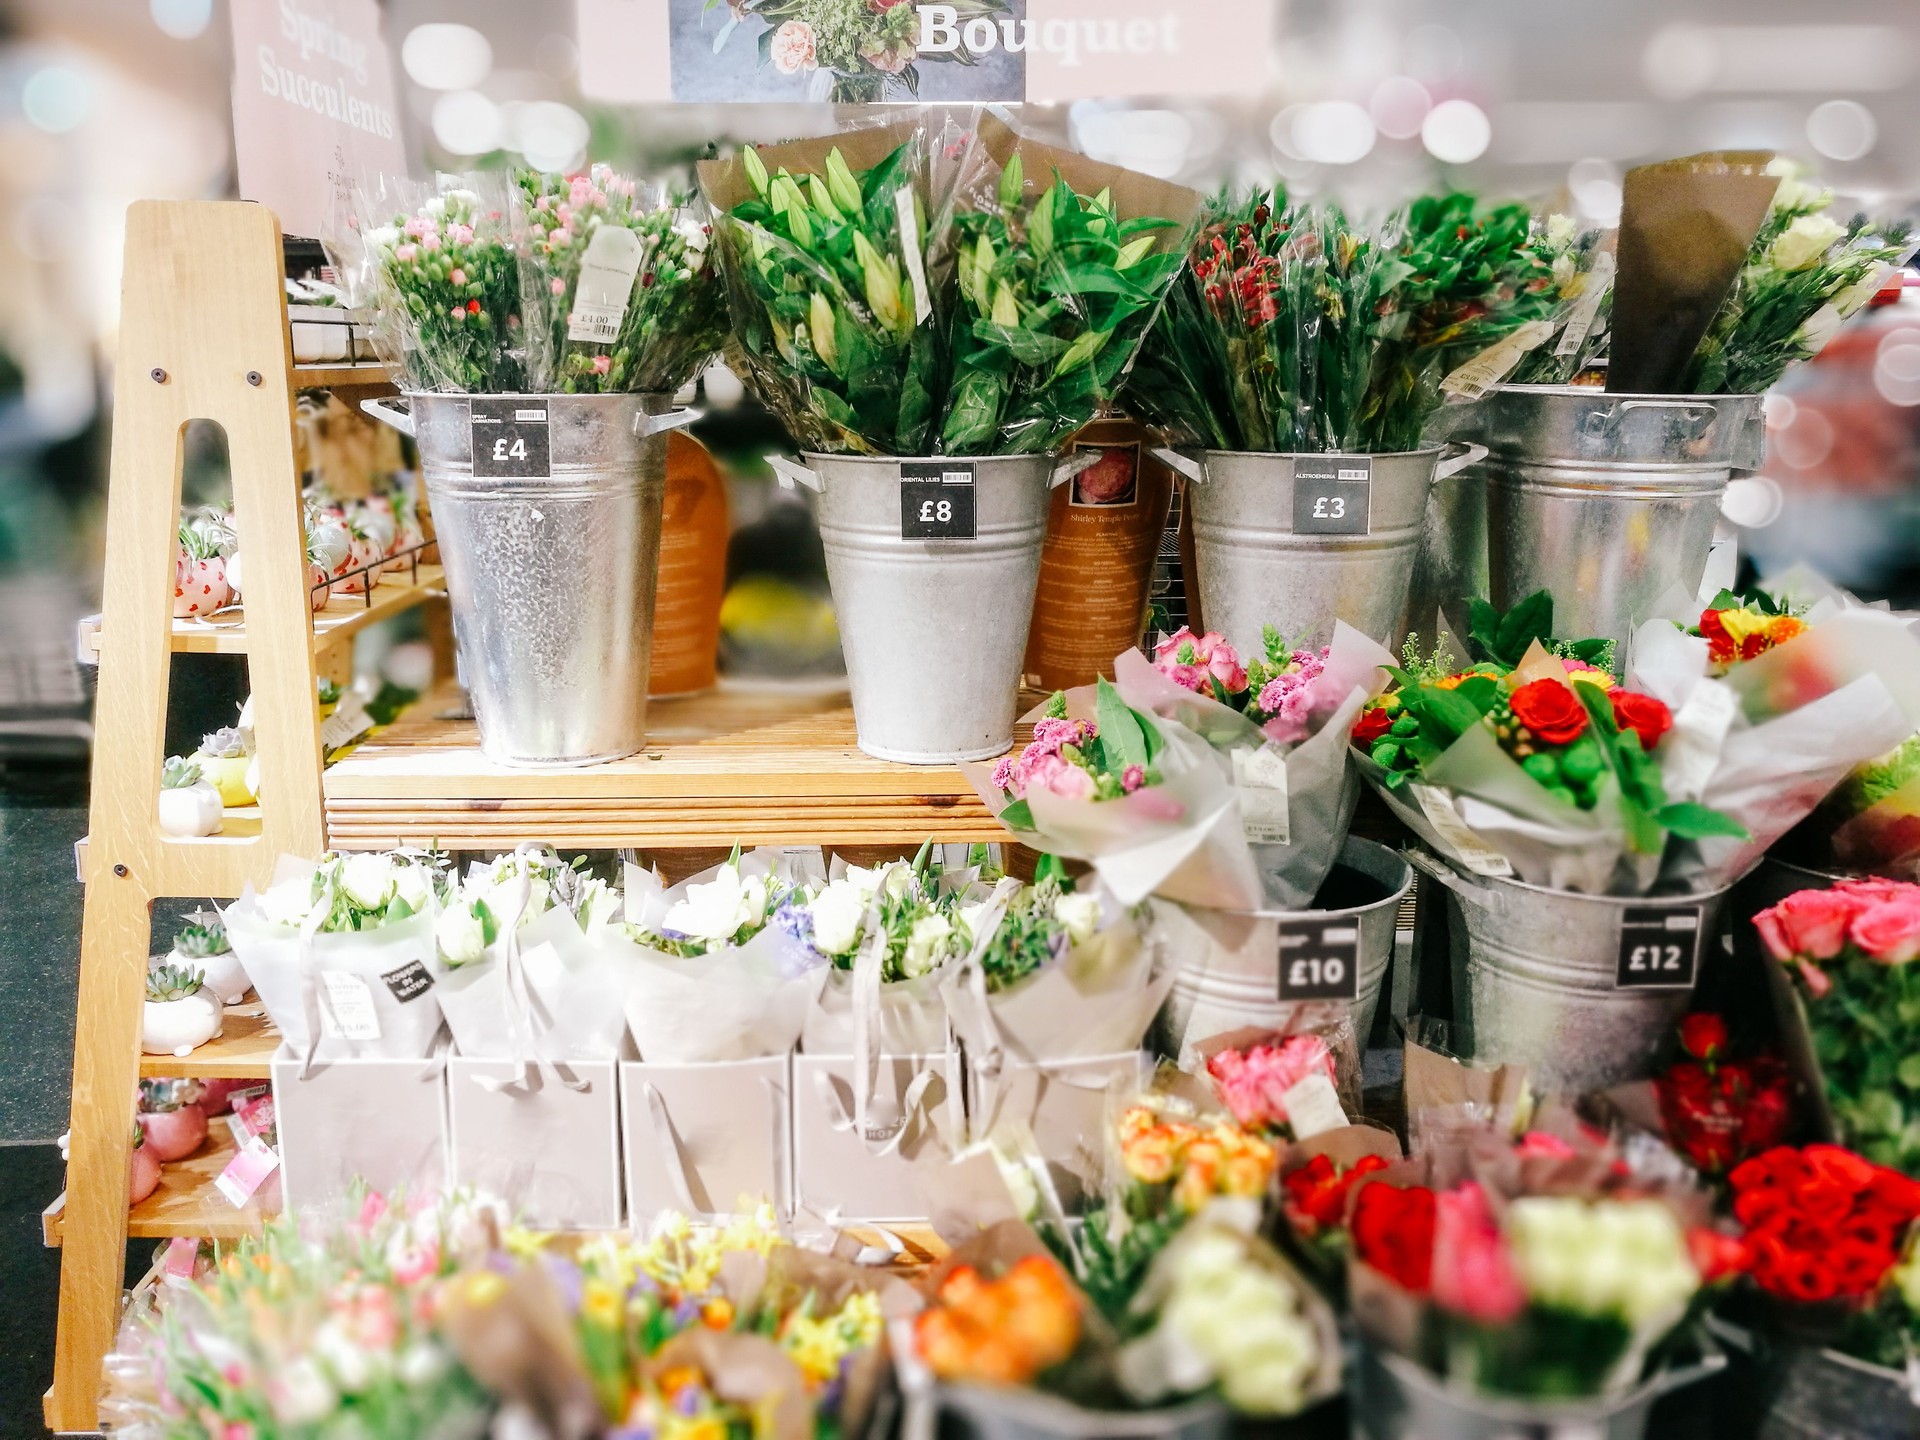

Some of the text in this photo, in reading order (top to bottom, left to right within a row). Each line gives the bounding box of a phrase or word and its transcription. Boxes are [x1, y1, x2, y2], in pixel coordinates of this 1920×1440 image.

[279, 0, 368, 86] Spring
[916, 4, 1181, 67] Bouquet
[258, 45, 392, 139] Succulents
[581, 314, 609, 325] £4.00
[492, 438, 528, 461] £4
[919, 500, 952, 522] £8
[1070, 513, 1096, 523] Shirley
[1312, 497, 1345, 519] £3
[1628, 945, 1681, 971] £12
[1288, 958, 1345, 986] £10
[865, 1128, 895, 1140] HOP
